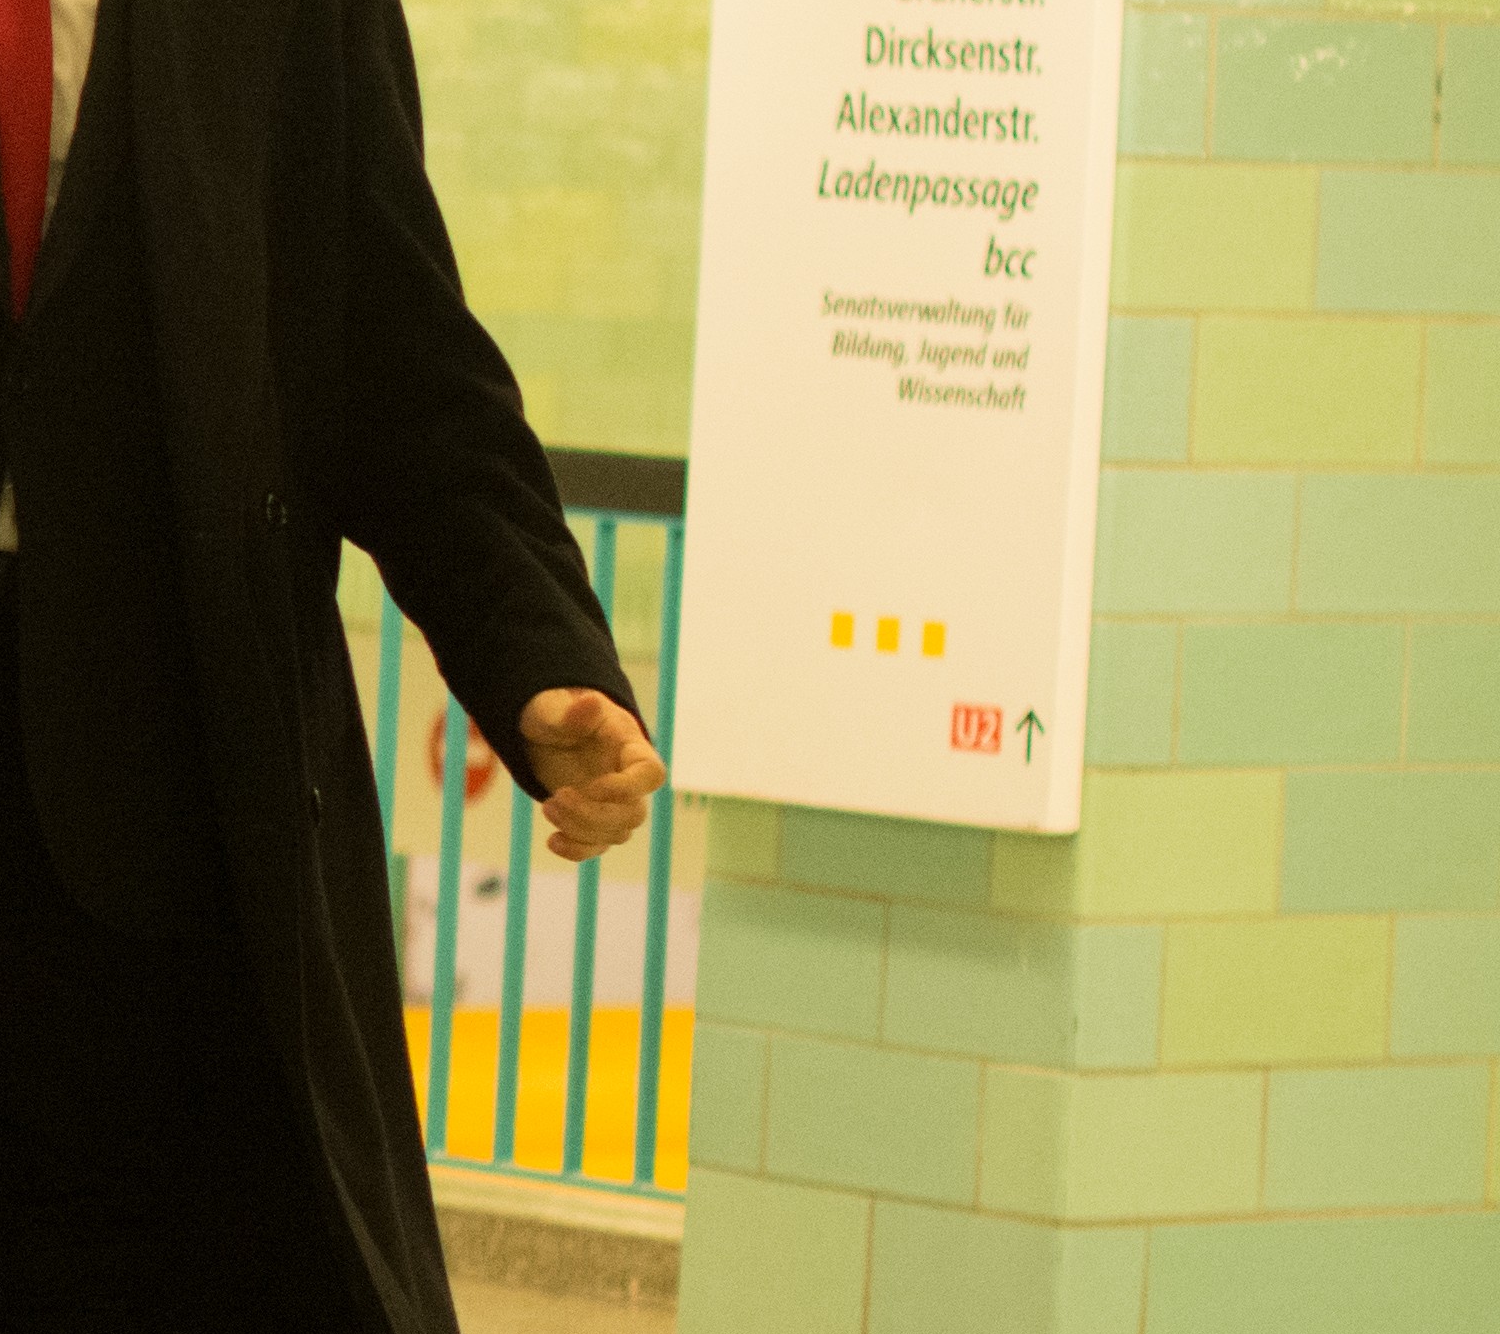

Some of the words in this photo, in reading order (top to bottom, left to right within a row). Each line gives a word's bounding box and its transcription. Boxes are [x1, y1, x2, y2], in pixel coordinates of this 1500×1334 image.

[865, 26, 1042, 75] Dircksenstr.
[836, 91, 1039, 144] Alexanderstr.
[818, 159, 1039, 221] Ladenpassage
[984, 235, 1037, 279] bcc
[993, 345, 1030, 370] und
[955, 709, 997, 750] U2
